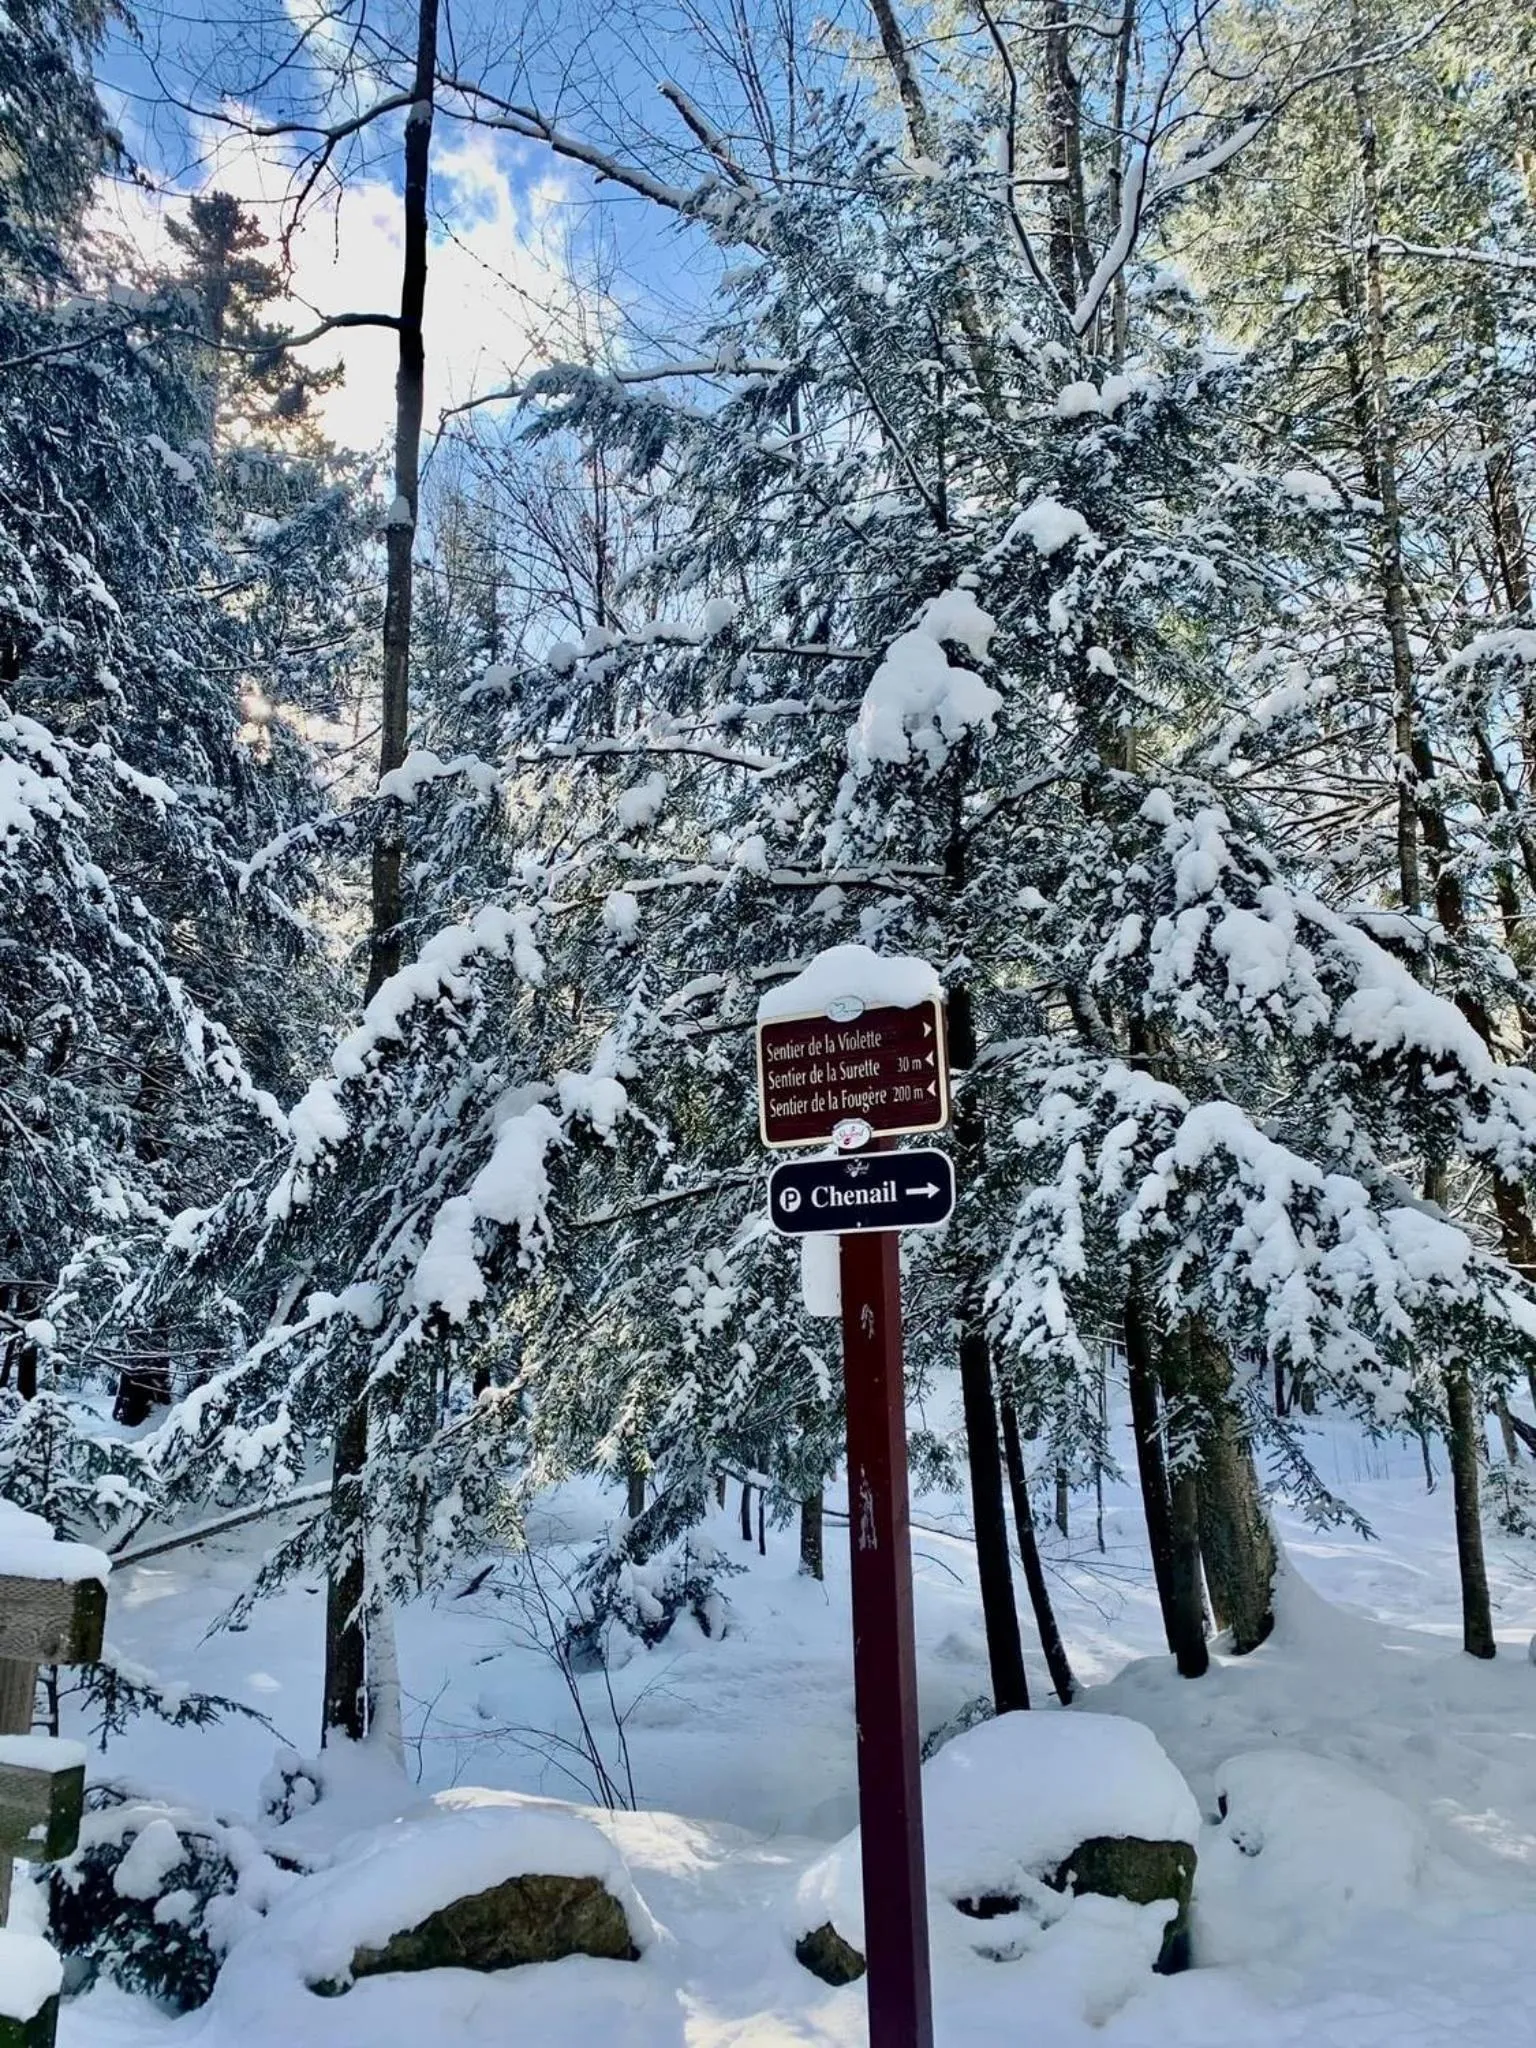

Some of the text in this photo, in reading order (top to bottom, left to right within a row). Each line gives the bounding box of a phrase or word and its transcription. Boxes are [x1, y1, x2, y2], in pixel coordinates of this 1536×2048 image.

[766, 1030, 882, 1062] Sentier de la Violette
[768, 1057, 922, 1090] Sentier de la Surette 30 m
[770, 1095, 807, 1117] Sentier
[811, 1092, 825, 1113] de
[828, 1090, 838, 1109] la
[892, 1086, 911, 1102] 200
[914, 1088, 923, 1099] m
[811, 1180, 897, 1208] Chenail
